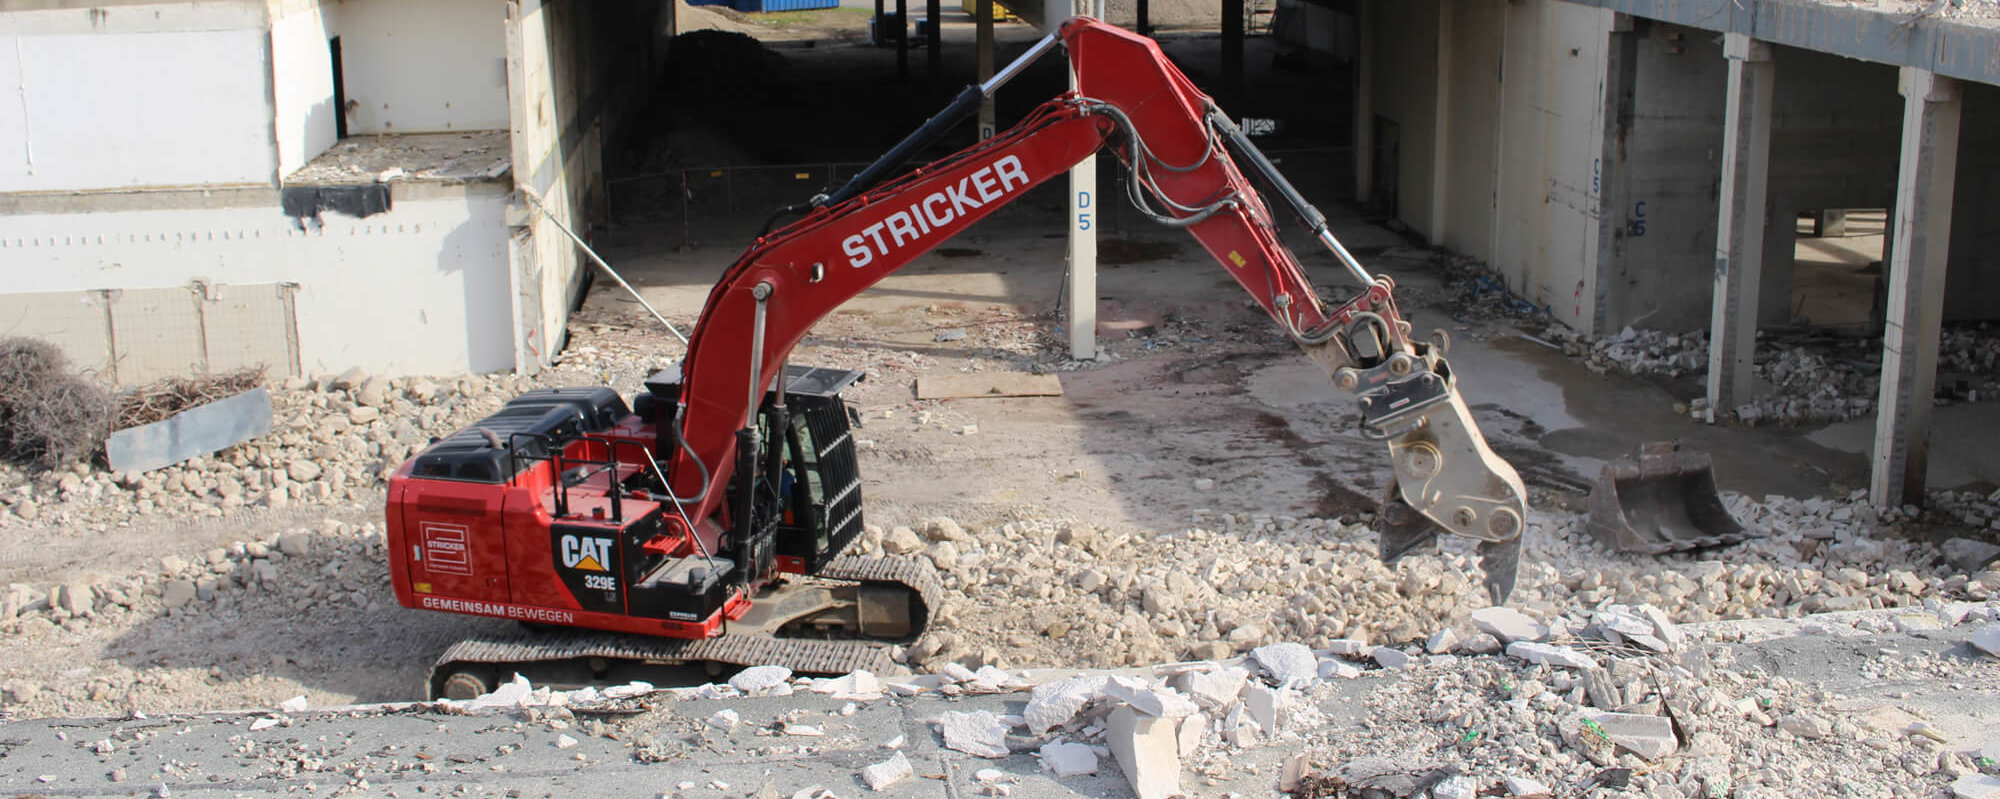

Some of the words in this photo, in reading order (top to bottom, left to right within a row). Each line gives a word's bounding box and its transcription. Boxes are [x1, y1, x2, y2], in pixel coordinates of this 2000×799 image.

[983, 127, 992, 140] D
[1078, 191, 1090, 208] D
[842, 155, 1030, 268] STRICKER
[1635, 201, 1646, 218] C
[1079, 213, 1090, 230] 5
[427, 540, 465, 551] STRICKER
[561, 534, 613, 571] CAT
[584, 574, 616, 590] 329E
[423, 596, 505, 616] GEMEINSAM
[508, 607, 574, 624] BEWEGEN
